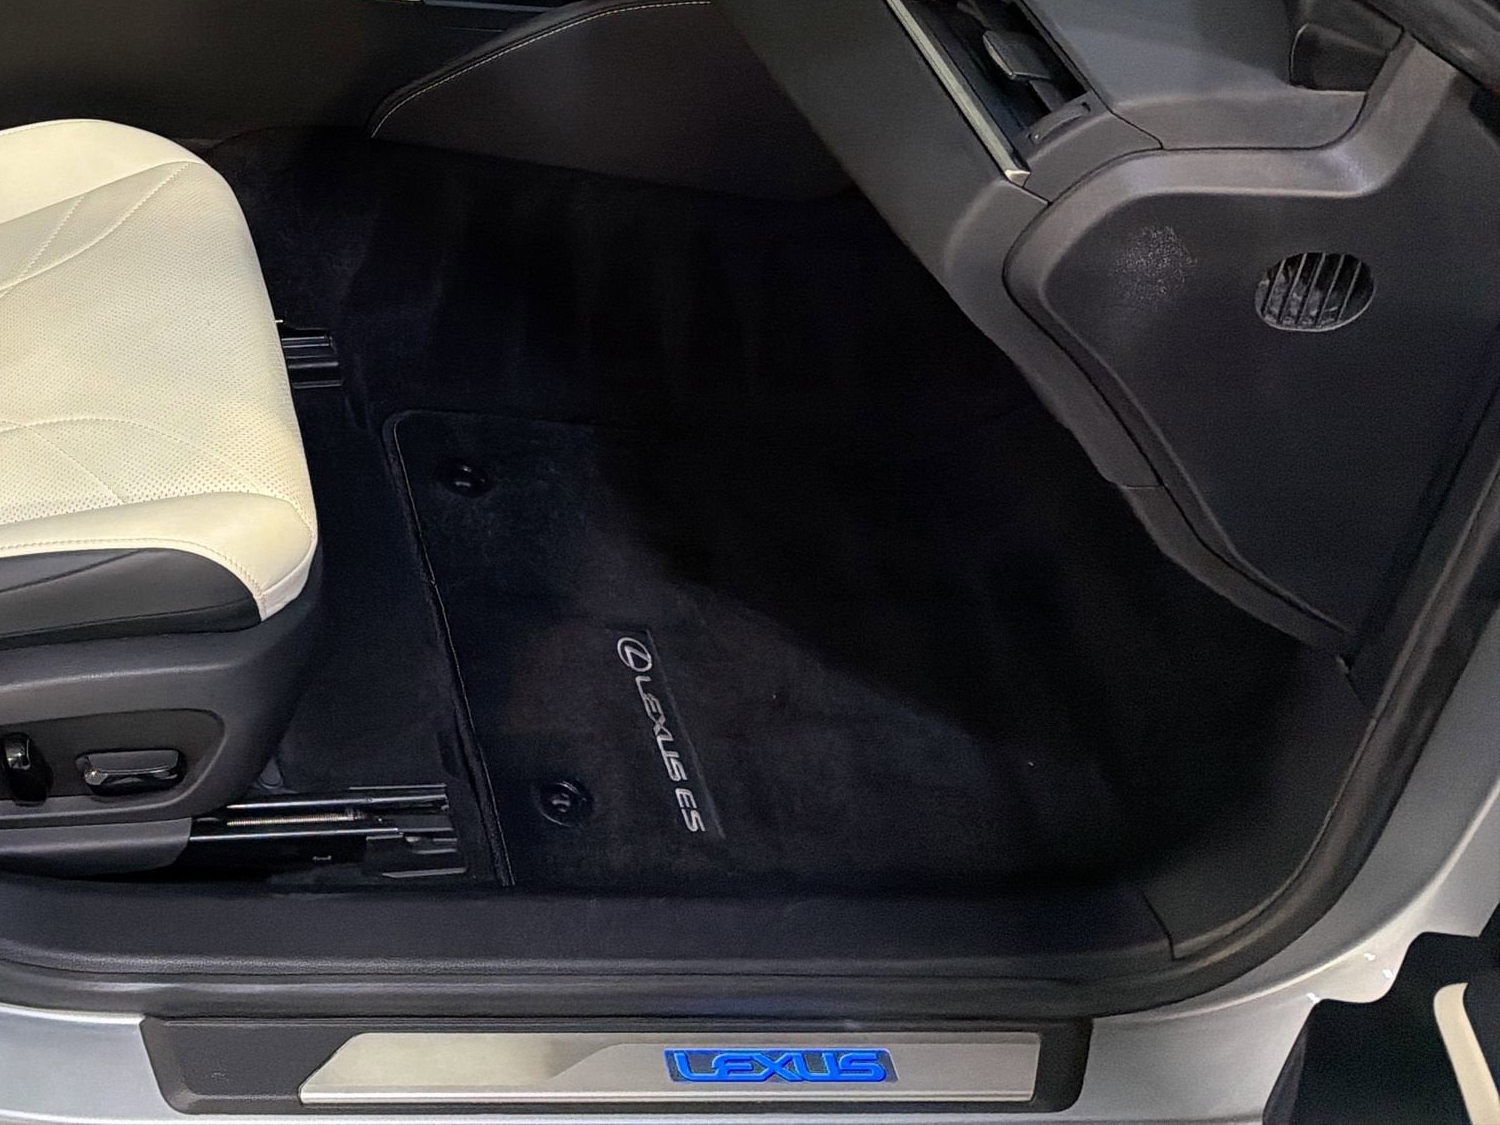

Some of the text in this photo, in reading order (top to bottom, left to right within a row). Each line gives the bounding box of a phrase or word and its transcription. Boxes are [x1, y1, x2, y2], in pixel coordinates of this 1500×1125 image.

[635, 675, 706, 832] LEXUS ES
[673, 1051, 887, 1083] LEXUS
